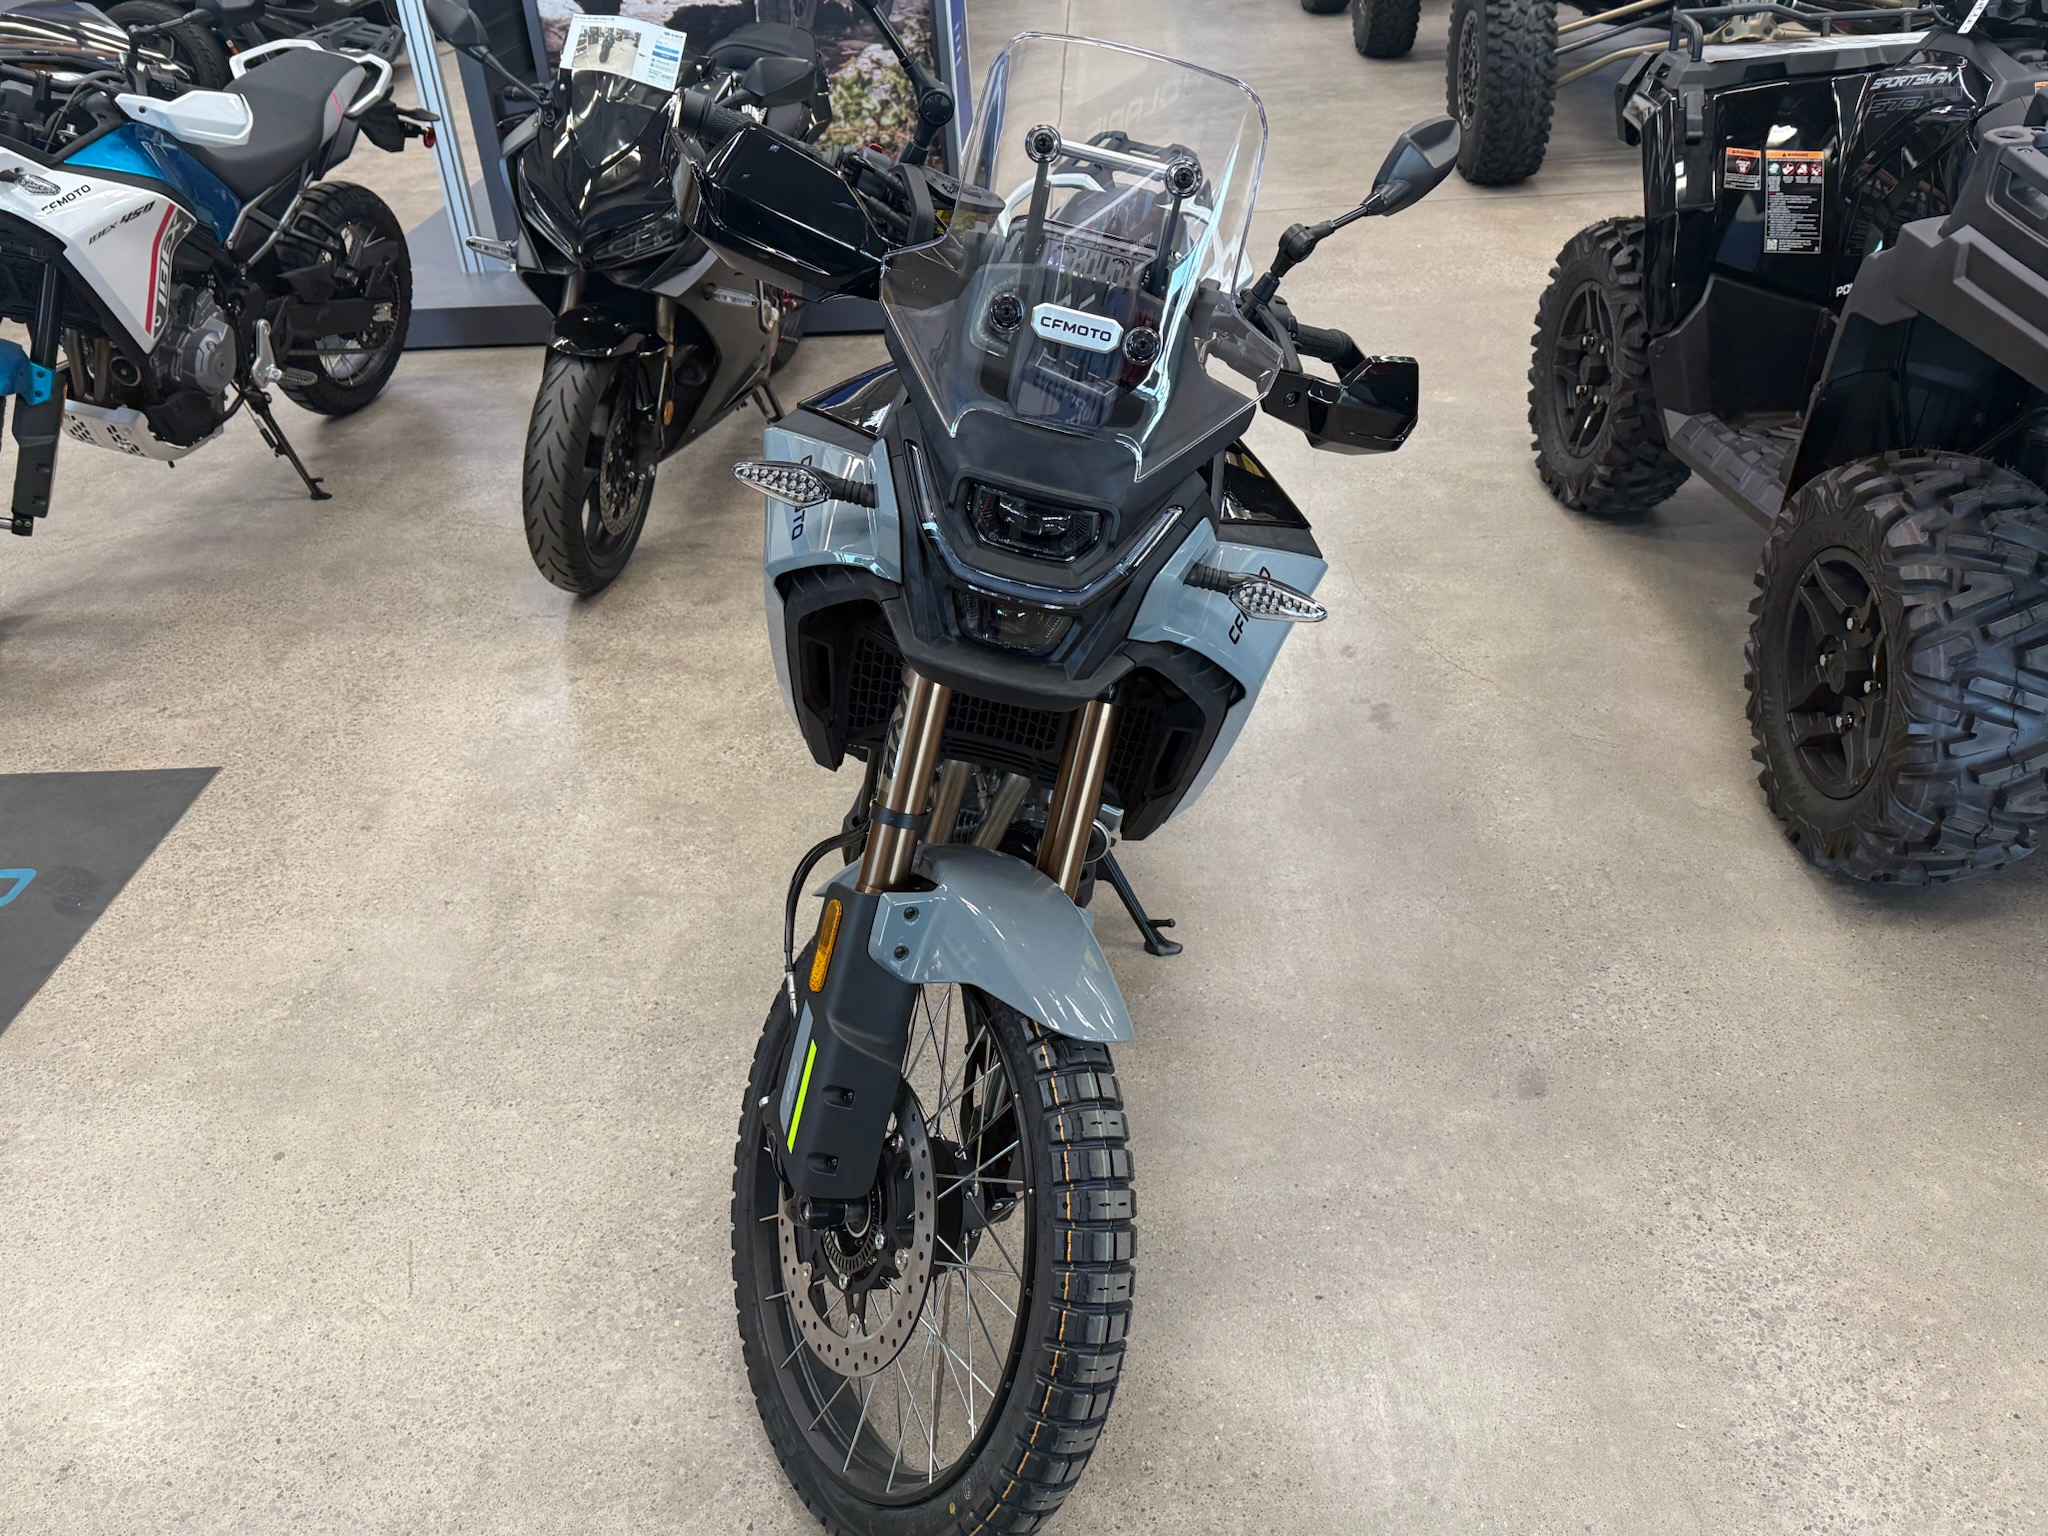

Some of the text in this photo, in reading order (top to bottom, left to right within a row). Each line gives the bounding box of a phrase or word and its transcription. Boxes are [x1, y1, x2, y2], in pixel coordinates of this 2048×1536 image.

[1869, 71, 1960, 90] SPORTSMAN
[41, 184, 91, 215] CFMOTO
[119, 200, 156, 224] 450
[158, 215, 182, 308] IBEX
[1040, 316, 1112, 342] CFMOTO
